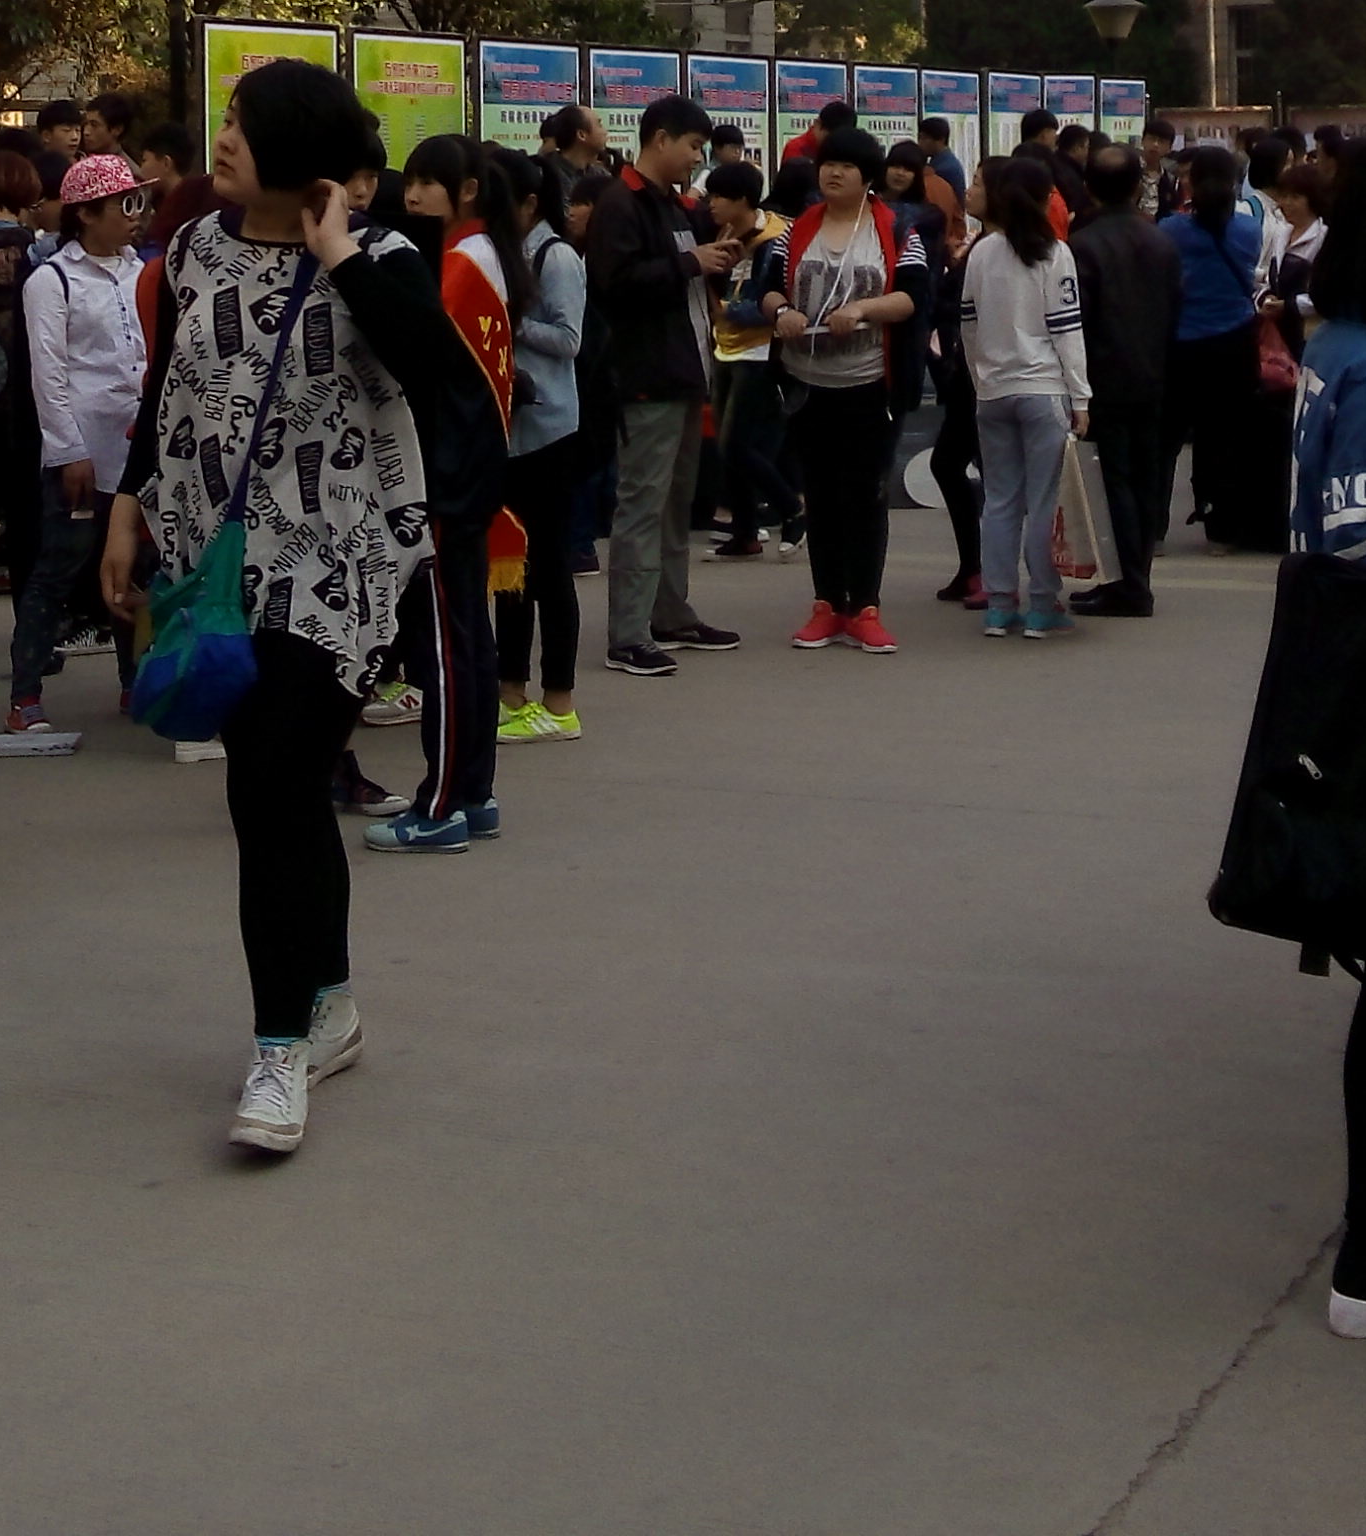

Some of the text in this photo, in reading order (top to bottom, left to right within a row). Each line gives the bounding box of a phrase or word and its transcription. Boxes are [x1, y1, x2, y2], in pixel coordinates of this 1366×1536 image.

[257, 293, 291, 327] NYC
[1059, 277, 1078, 305] 3
[189, 314, 208, 360] MILAN
[306, 307, 331, 372] LONDON
[204, 367, 232, 422] BERLIN
[288, 379, 332, 434] BERLIN
[222, 395, 257, 455] Paris
[272, 522, 319, 574] BERLIN
[393, 506, 427, 540] NYC
[376, 586, 390, 640] MILAN
